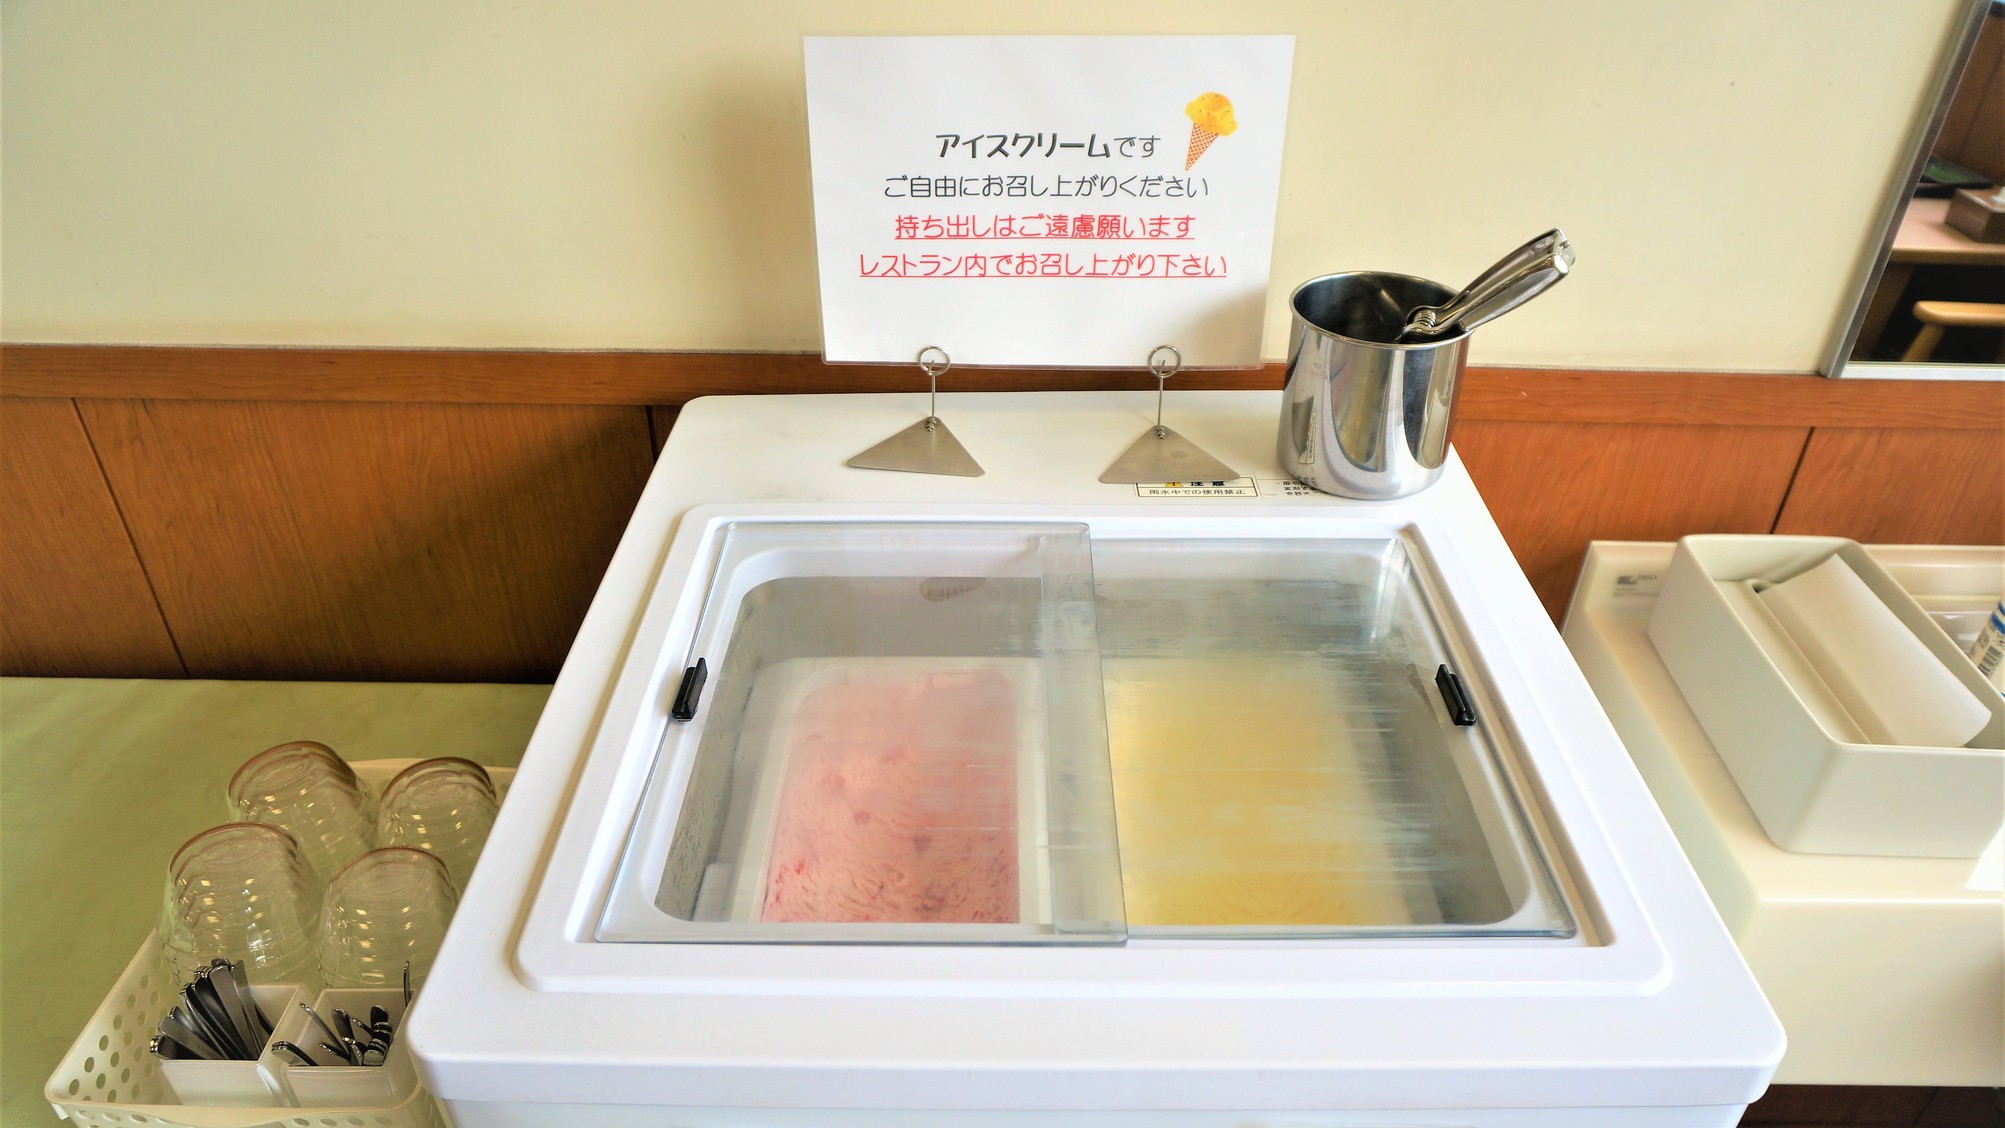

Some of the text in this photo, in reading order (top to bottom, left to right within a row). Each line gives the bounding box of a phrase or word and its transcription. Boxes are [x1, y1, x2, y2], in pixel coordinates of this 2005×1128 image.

[936, 132, 1161, 159] アイスクリームです
[884, 173, 1209, 198] ご自由にお召し上がりください
[895, 213, 1196, 239] 持ち出しはご遠慮願います
[860, 252, 1228, 277] レストラン内でお召し上がり下さい
